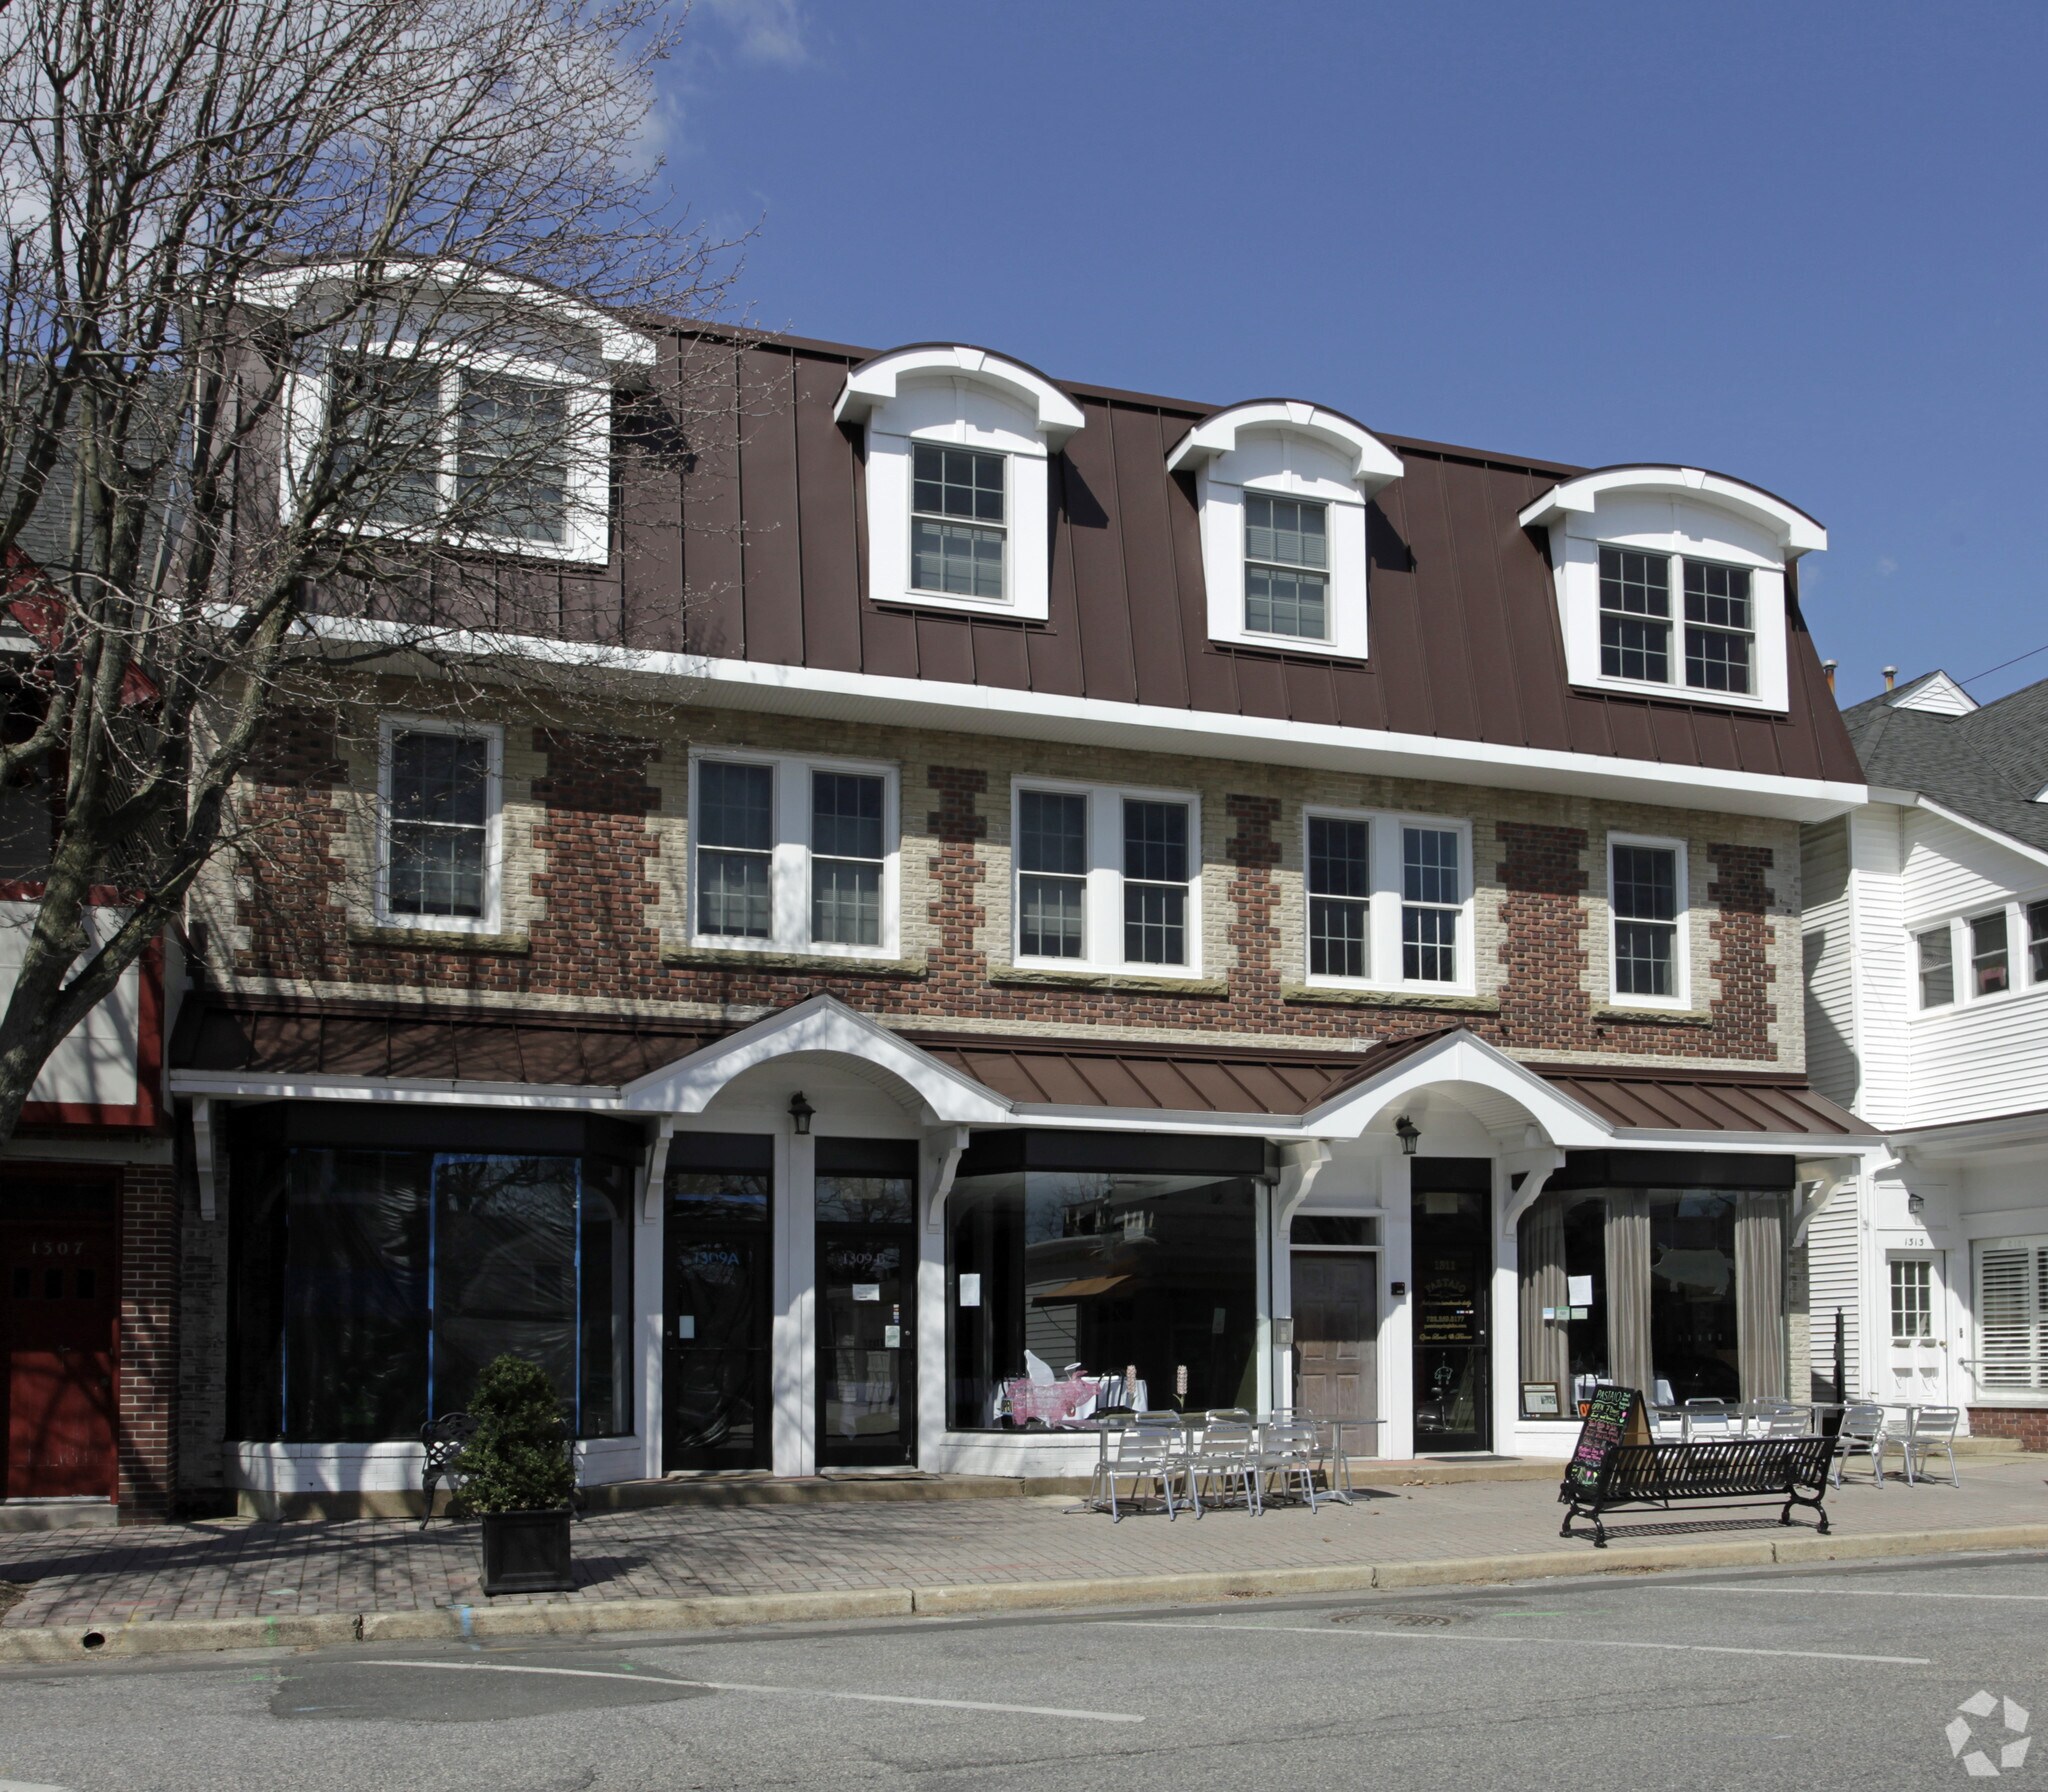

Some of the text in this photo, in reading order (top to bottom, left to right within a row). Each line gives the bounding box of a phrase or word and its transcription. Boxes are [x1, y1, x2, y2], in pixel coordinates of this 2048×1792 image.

[695, 1251, 740, 1265] 1309A
[1425, 1278, 1466, 1293] PASTAIO
[1596, 1389, 1622, 1403] PASTAIO
